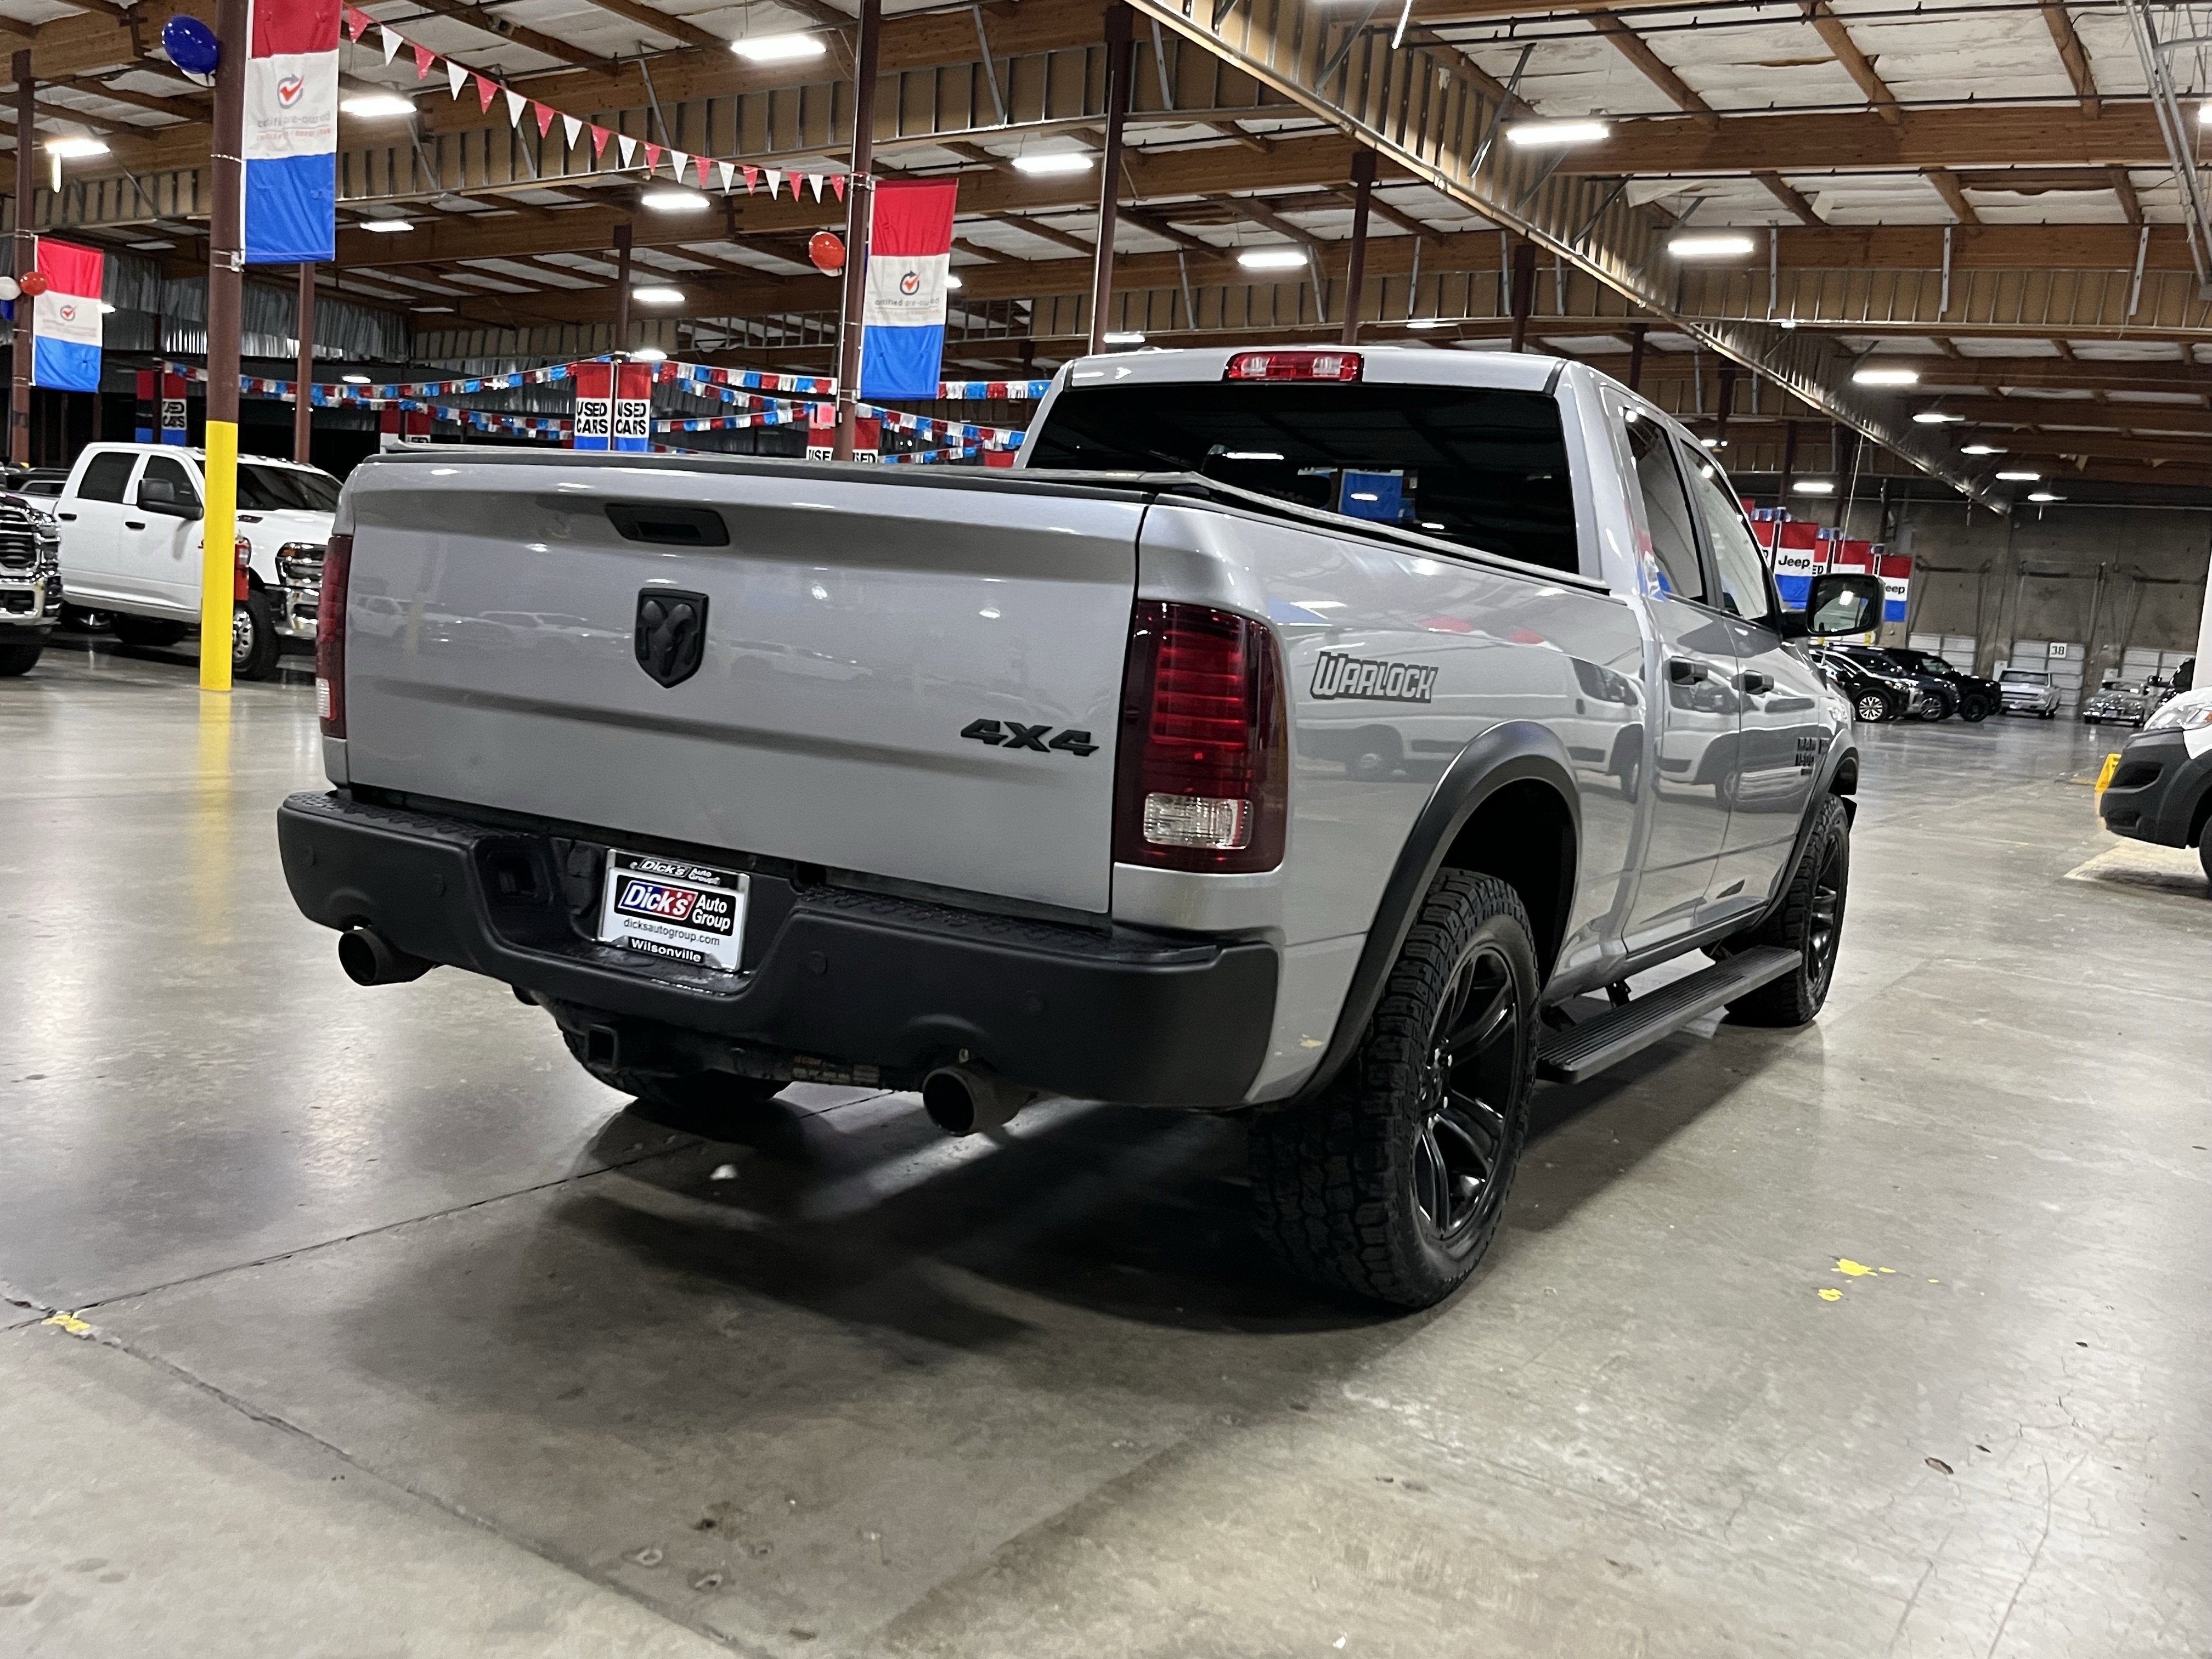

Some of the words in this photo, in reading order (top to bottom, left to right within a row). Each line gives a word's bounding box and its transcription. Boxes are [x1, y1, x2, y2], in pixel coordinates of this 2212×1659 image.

[577, 401, 607, 417] USED
[618, 402, 646, 417] USED
[577, 418, 608, 434] CARS
[616, 419, 646, 435] CARS
[1778, 555, 1810, 569] Jeep
[1885, 584, 1905, 595] eep
[1310, 651, 1438, 703] WARLOCK
[691, 868, 712, 877] Auto
[624, 884, 689, 916] Dick's
[695, 894, 727, 913] Auto
[692, 909, 731, 932] Group
[624, 918, 720, 946] dicksautogroup.com
[631, 938, 702, 962] Wilsonville
